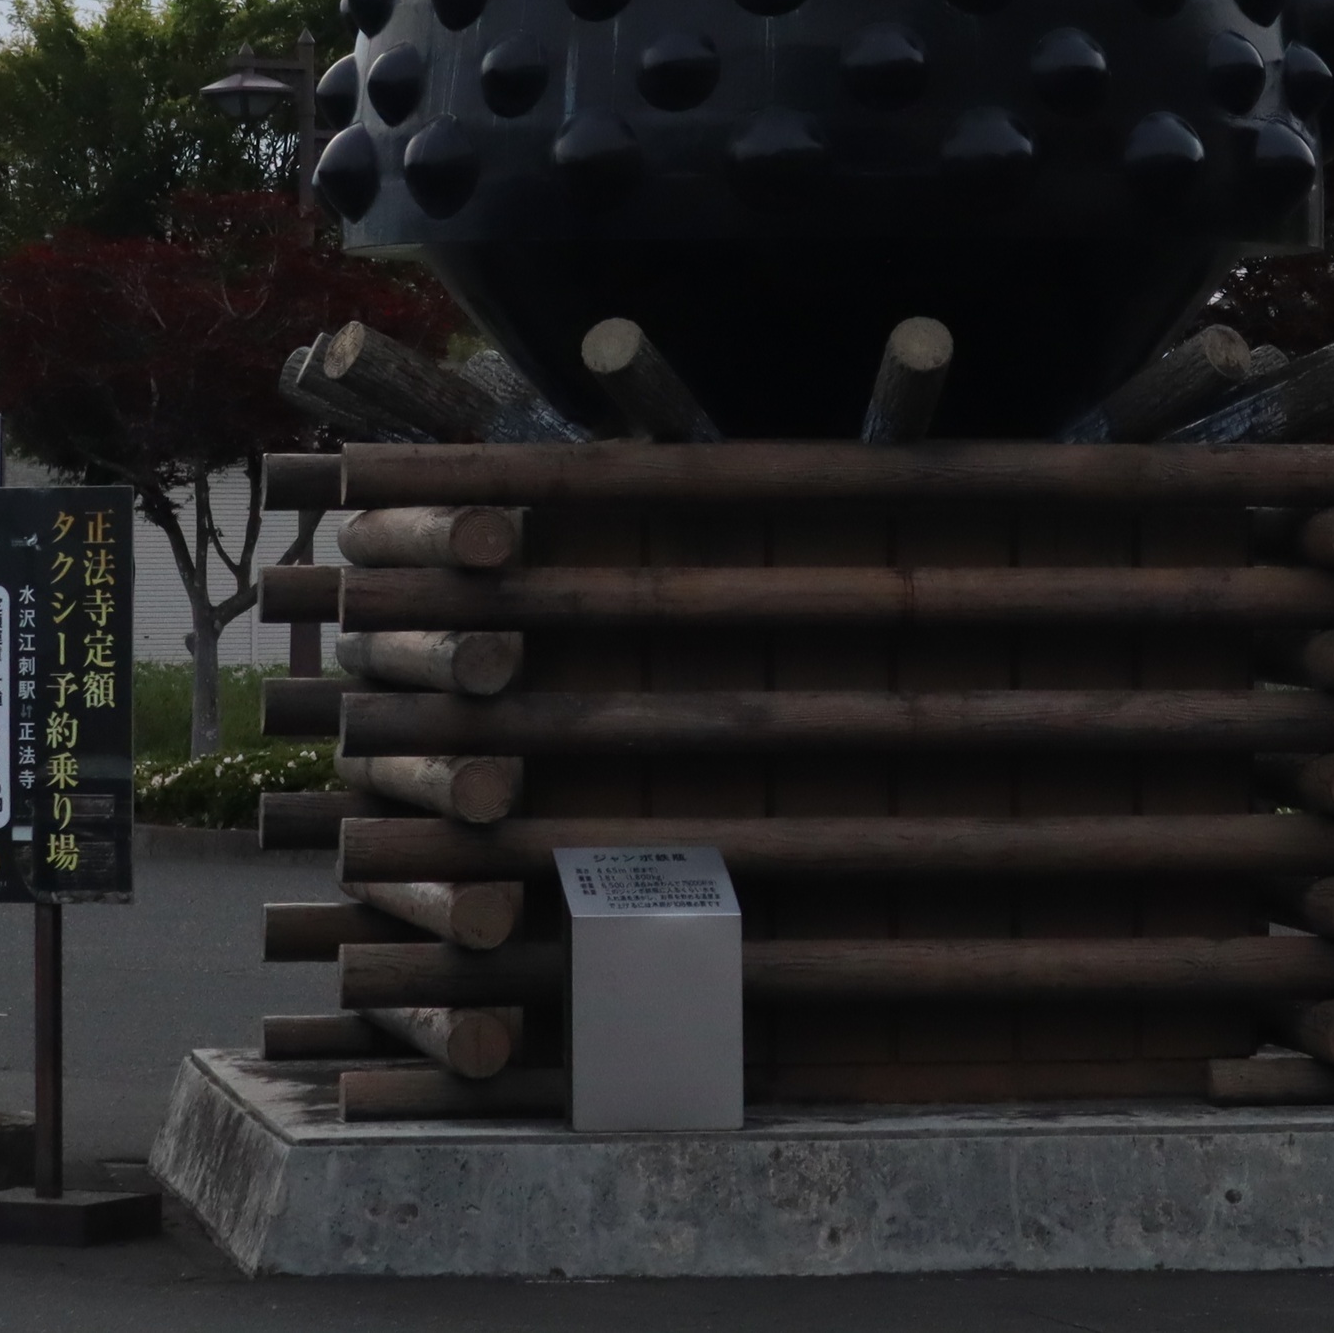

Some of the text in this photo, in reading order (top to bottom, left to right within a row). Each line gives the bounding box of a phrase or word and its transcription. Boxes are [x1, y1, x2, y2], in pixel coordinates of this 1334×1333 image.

[18, 585, 36, 789] 水沢江刺駅 正法寺
[45, 510, 80, 871] タクシー予約乗り場
[83, 509, 116, 709] 正法寺定額
